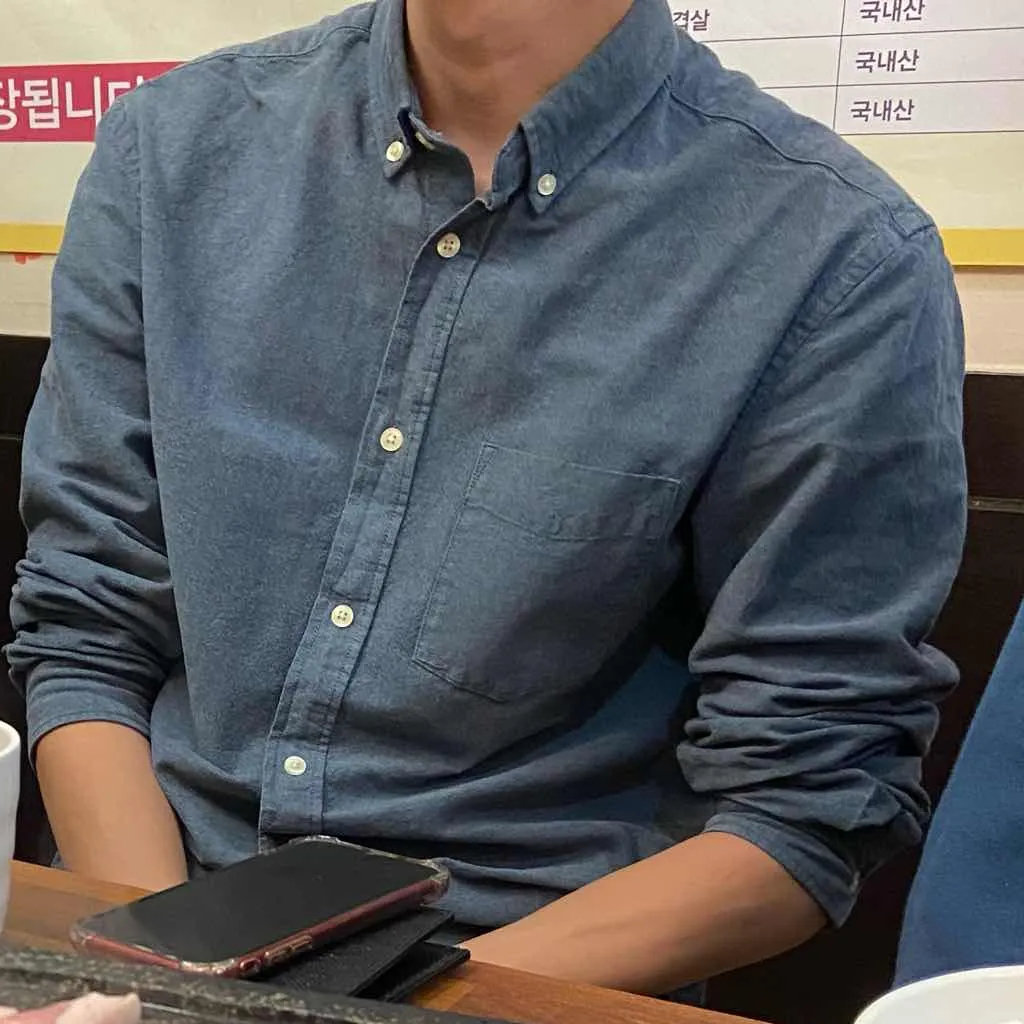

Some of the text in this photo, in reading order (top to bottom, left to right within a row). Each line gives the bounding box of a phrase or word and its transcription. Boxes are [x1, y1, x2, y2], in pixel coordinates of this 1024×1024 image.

[860, 0, 925, 23] 국내산
[856, 49, 919, 73] 국내산
[850, 99, 915, 122] 국내산
